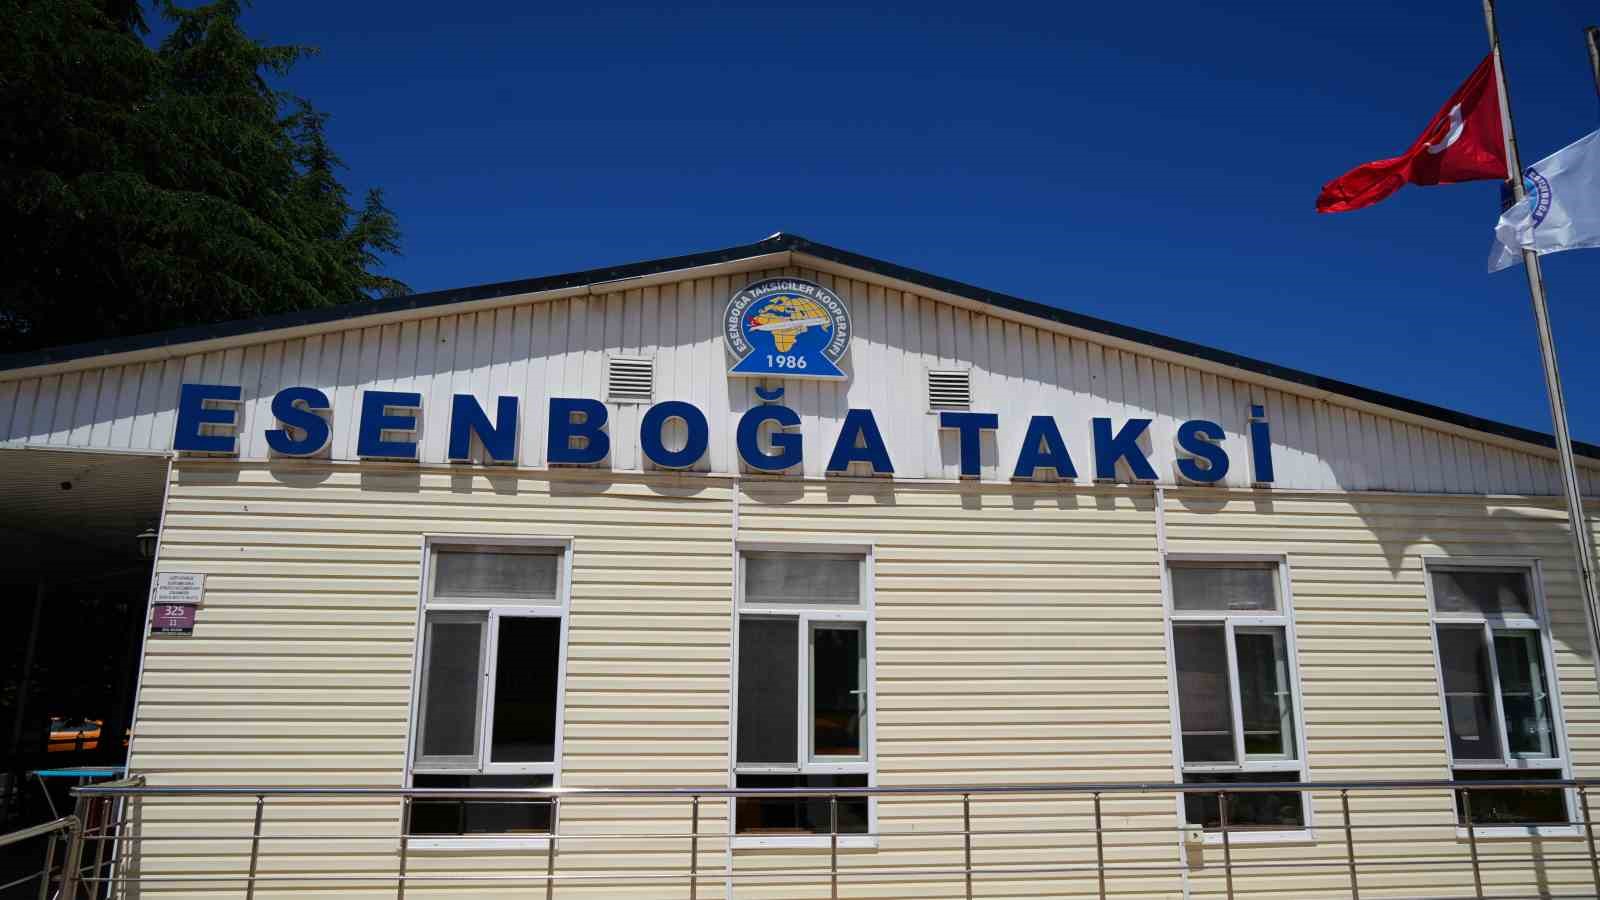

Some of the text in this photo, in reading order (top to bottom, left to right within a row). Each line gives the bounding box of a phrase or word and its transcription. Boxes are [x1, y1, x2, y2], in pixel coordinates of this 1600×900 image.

[728, 295, 751, 353] ESENBOĞA
[749, 281, 815, 298] TAKSİCİLER
[766, 355, 807, 369] 1986
[173, 383, 1274, 482] ESENBOĞA TAKSİ
[165, 606, 184, 616] 325
